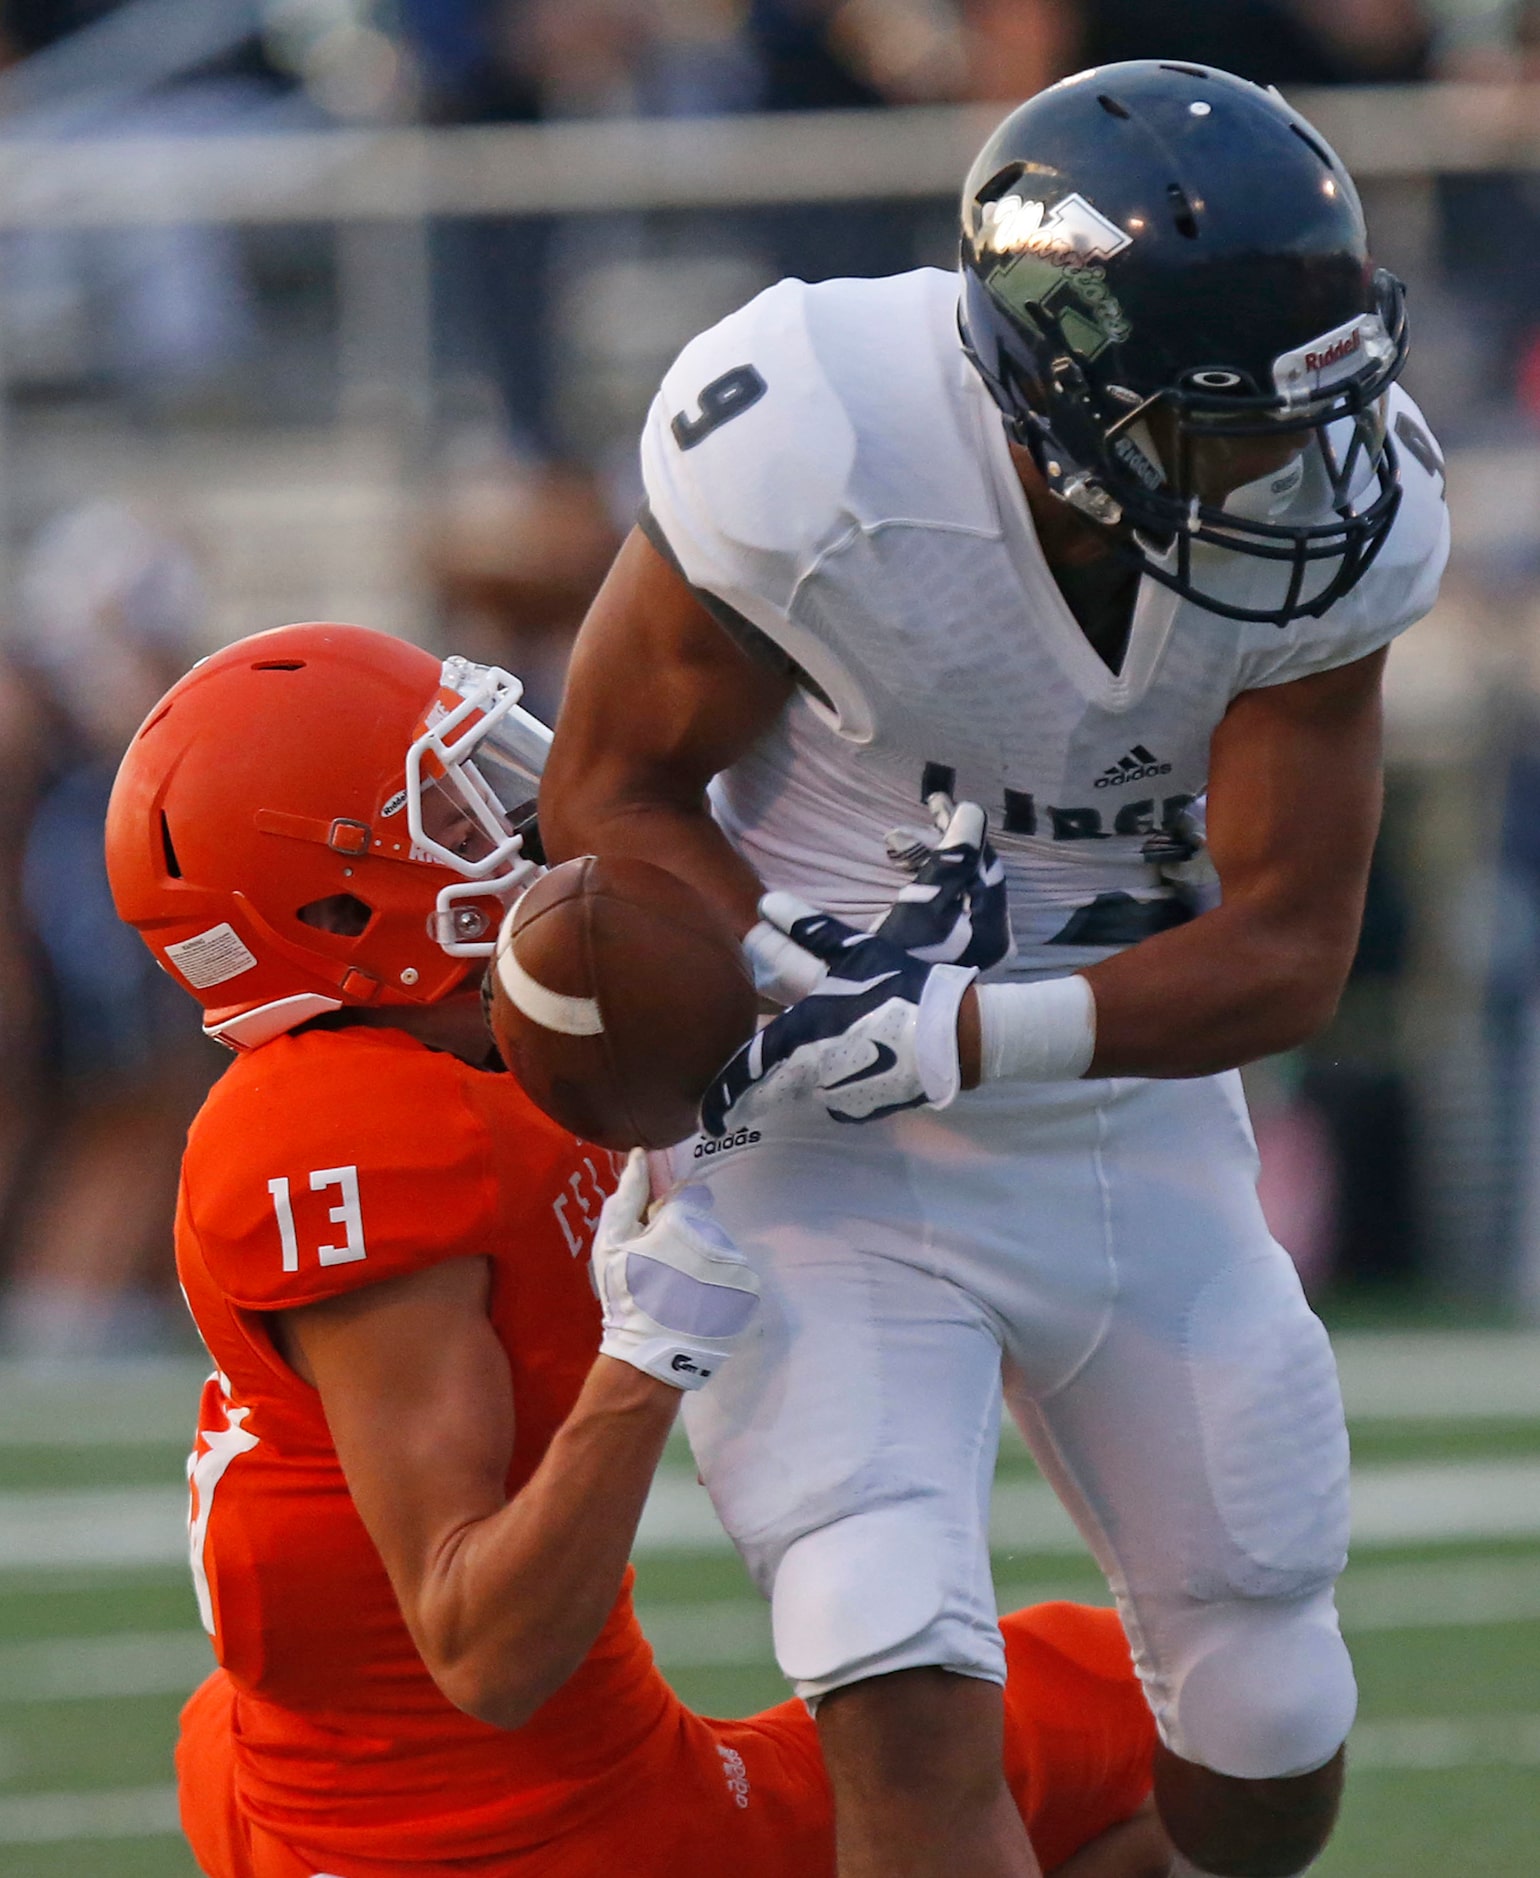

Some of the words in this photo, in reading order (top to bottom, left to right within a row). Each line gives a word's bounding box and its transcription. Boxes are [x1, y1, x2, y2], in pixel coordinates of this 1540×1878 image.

[1305, 328, 1361, 373] Riddell
[671, 363, 768, 452] 9
[1094, 762, 1172, 789] adidas
[694, 1131, 761, 1159] adidas
[267, 1165, 367, 1272] 13
